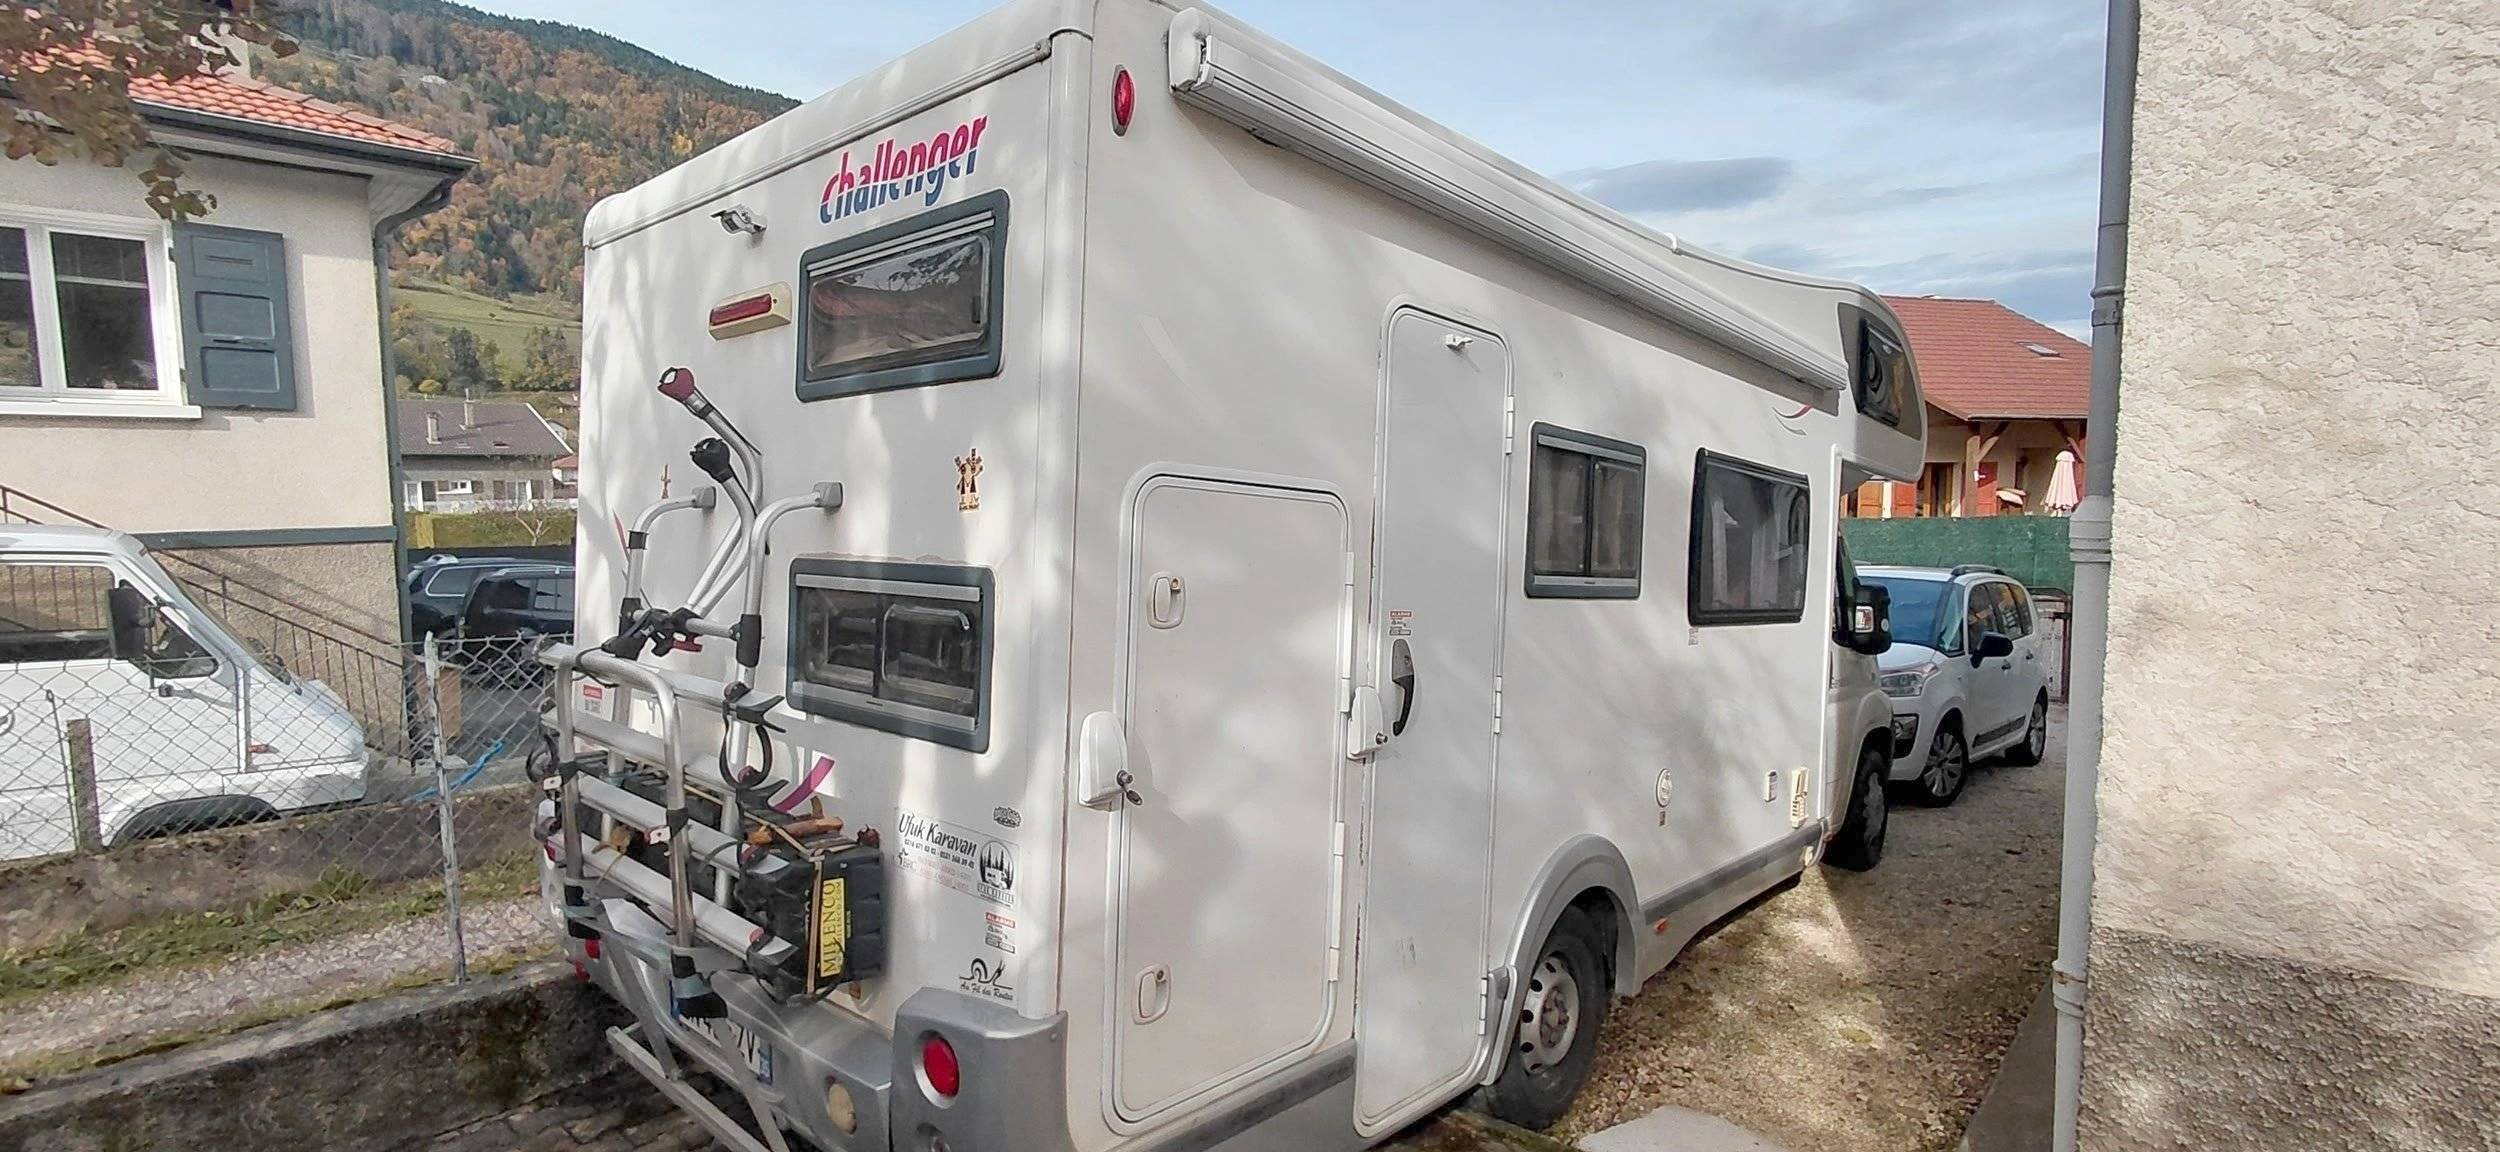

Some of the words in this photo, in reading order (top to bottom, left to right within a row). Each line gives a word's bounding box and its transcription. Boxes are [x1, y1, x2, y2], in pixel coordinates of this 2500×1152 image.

[819, 115, 988, 224] challenger
[899, 813, 926, 840] Ufuk
[926, 823, 978, 858] Karavan
[823, 882, 838, 974] MILENCO
